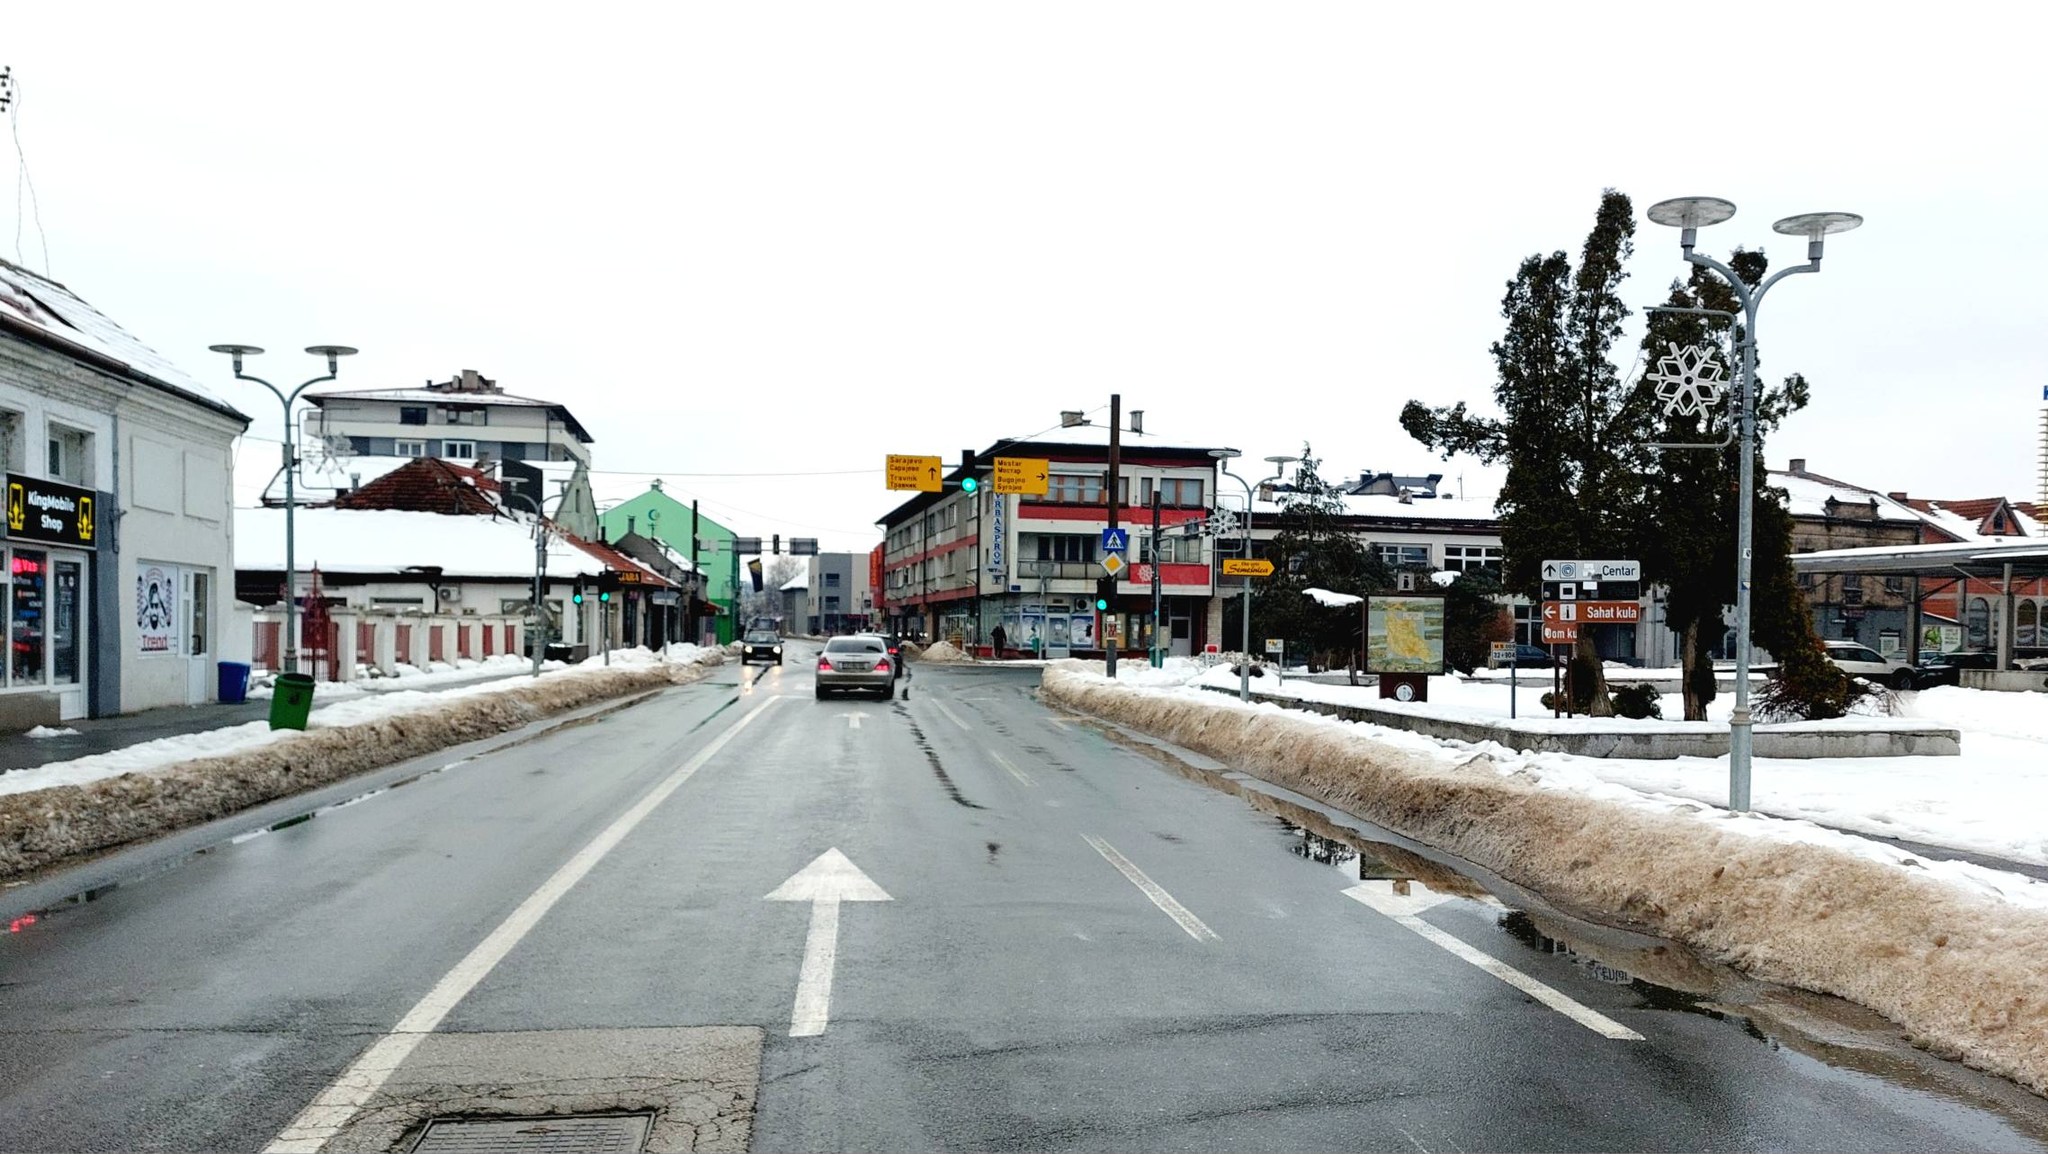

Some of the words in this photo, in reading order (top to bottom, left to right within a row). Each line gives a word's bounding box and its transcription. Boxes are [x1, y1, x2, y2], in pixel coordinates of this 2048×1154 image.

[889, 456, 923, 465] Sarajevo
[997, 459, 1022, 467] Mostar
[997, 476, 1026, 484] Bugojno
[28, 491, 75, 512] KingMobile
[41, 515, 63, 532] Shop
[1602, 565, 1636, 576] Centar
[1587, 606, 1614, 619] Sahat
[1616, 606, 1637, 619] kula
